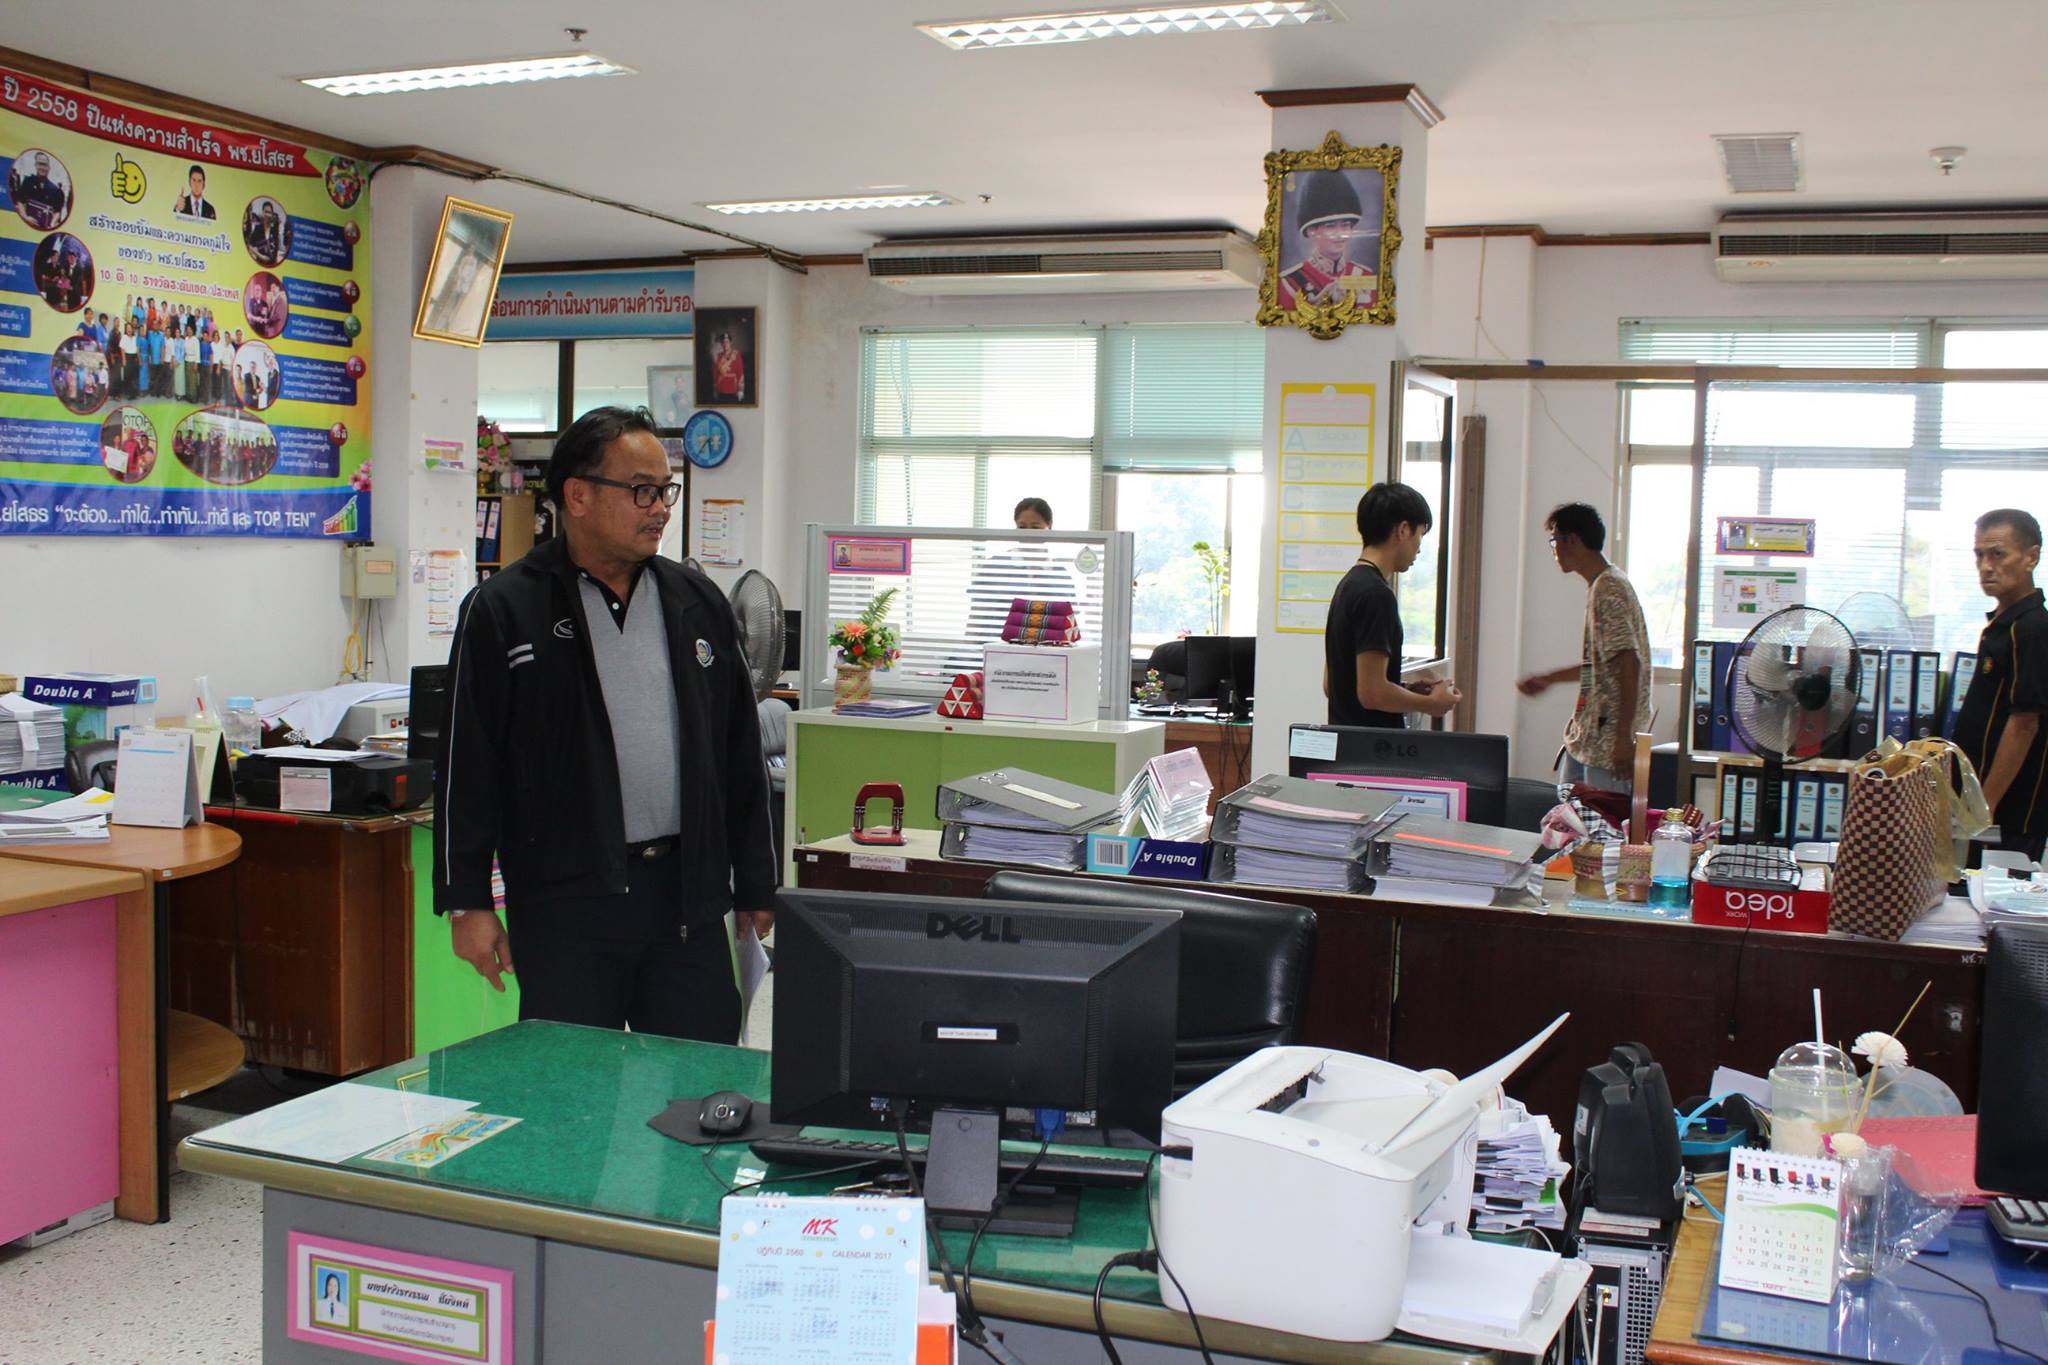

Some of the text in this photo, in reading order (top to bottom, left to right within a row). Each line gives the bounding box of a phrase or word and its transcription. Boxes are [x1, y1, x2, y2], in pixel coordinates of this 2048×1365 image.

[4, 75, 19, 102] ปี
[27, 88, 78, 121] 2558
[87, 104, 221, 157] ปีแห่งความสำเร็จ
[100, 269, 111, 280] 10
[254, 510, 281, 527] TOP
[33, 684, 80, 699] Double
[112, 690, 130, 698] Double
[1397, 744, 1419, 757] LG
[1155, 853, 1198, 867] Double
[1725, 891, 1795, 920] idea
[927, 912, 1022, 944] DELL
[802, 1217, 839, 1236] MK
[832, 1250, 871, 1258] CALENDAR
[874, 1252, 892, 1260] 2017
